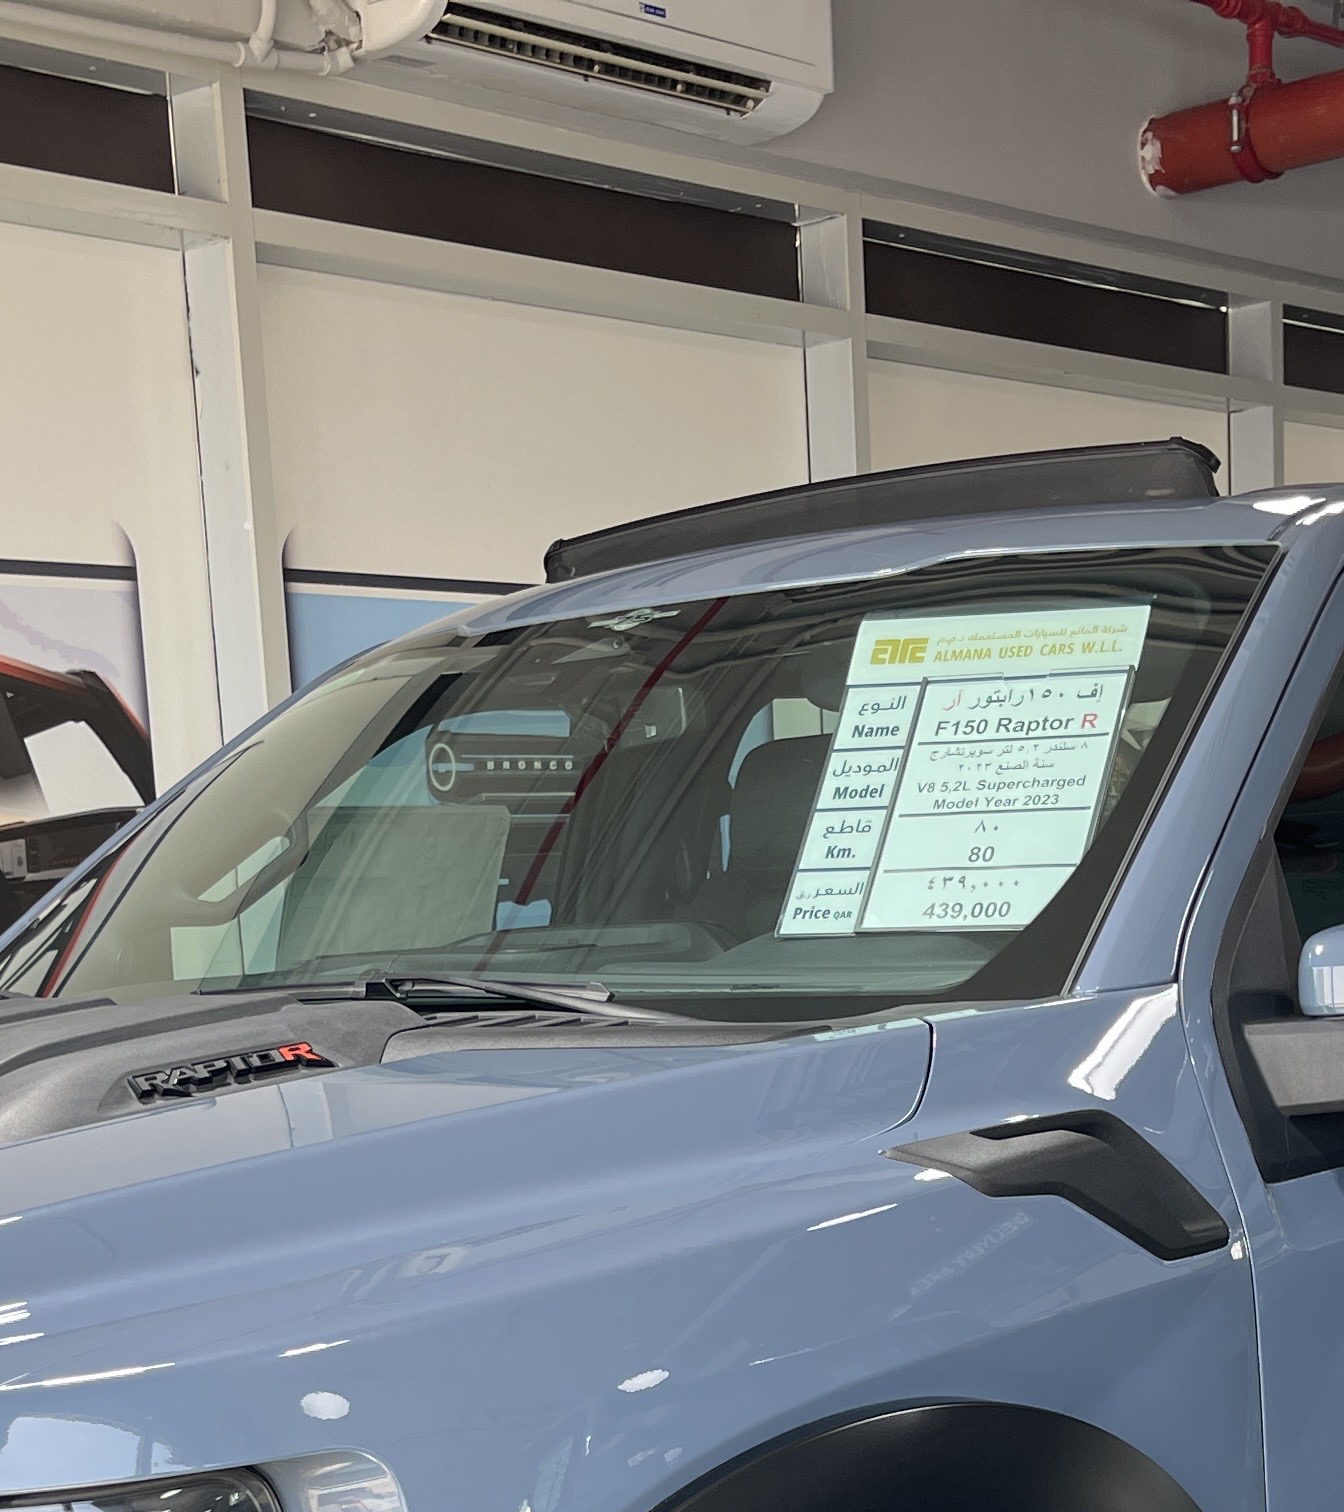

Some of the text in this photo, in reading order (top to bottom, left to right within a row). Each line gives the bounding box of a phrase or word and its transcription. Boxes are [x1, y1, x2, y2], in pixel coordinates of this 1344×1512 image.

[933, 647, 991, 663] ALMANA
[998, 645, 1033, 659] USED
[1040, 643, 1075, 656] CARS
[1082, 640, 1123, 653] W.L.L.
[851, 724, 900, 739] Name
[934, 713, 1098, 737] F150 Raptor R
[487, 760, 573, 770] BRONCO
[832, 756, 900, 778] الموديل
[832, 783, 885, 800] Model
[917, 782, 935, 794] V8
[976, 775, 1087, 793] Supercharged
[932, 794, 1060, 811] Model Year 2023
[822, 818, 873, 839] قاطع
[825, 845, 857, 860] Km.
[968, 845, 995, 863] 80
[792, 905, 853, 921] Price QAR
[922, 901, 1012, 921] 439,000
[129, 1041, 341, 1102] RAPTOR
